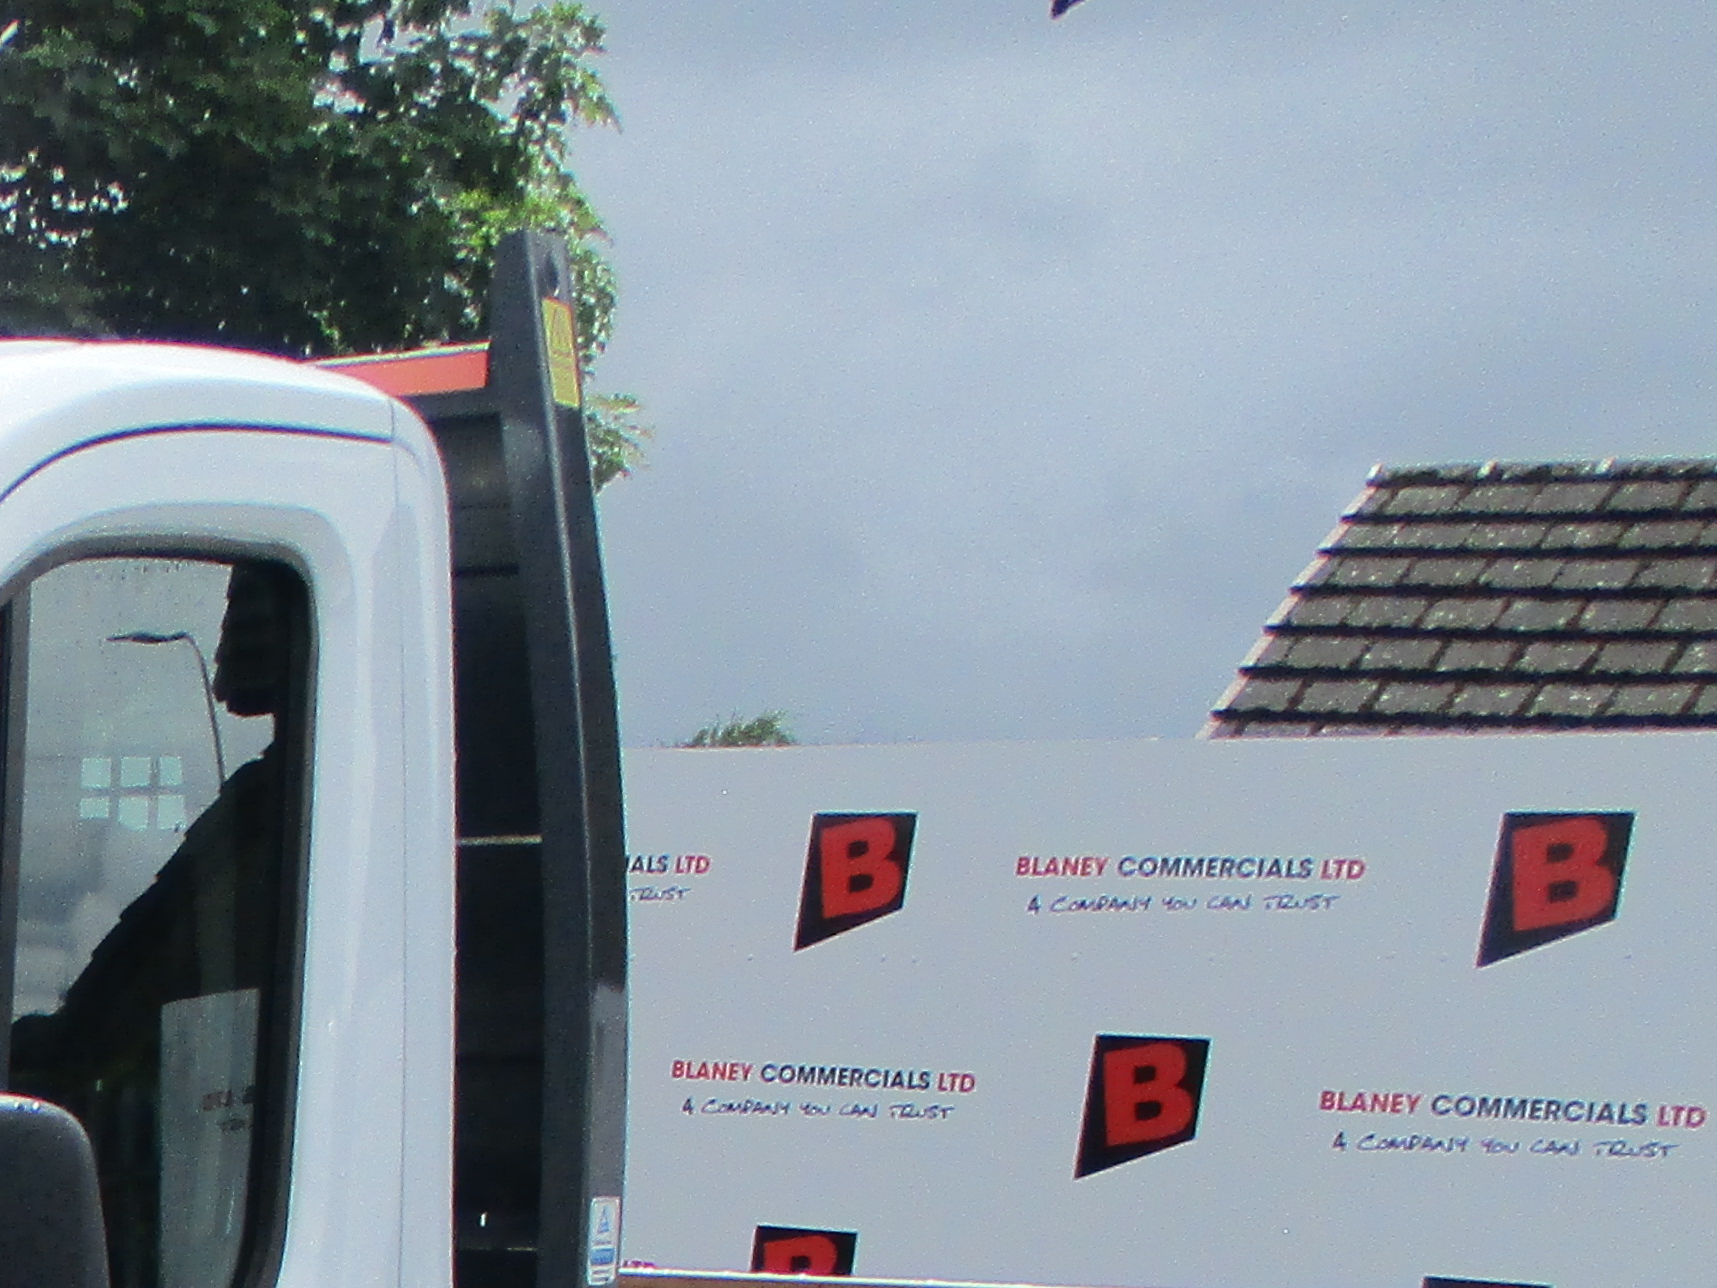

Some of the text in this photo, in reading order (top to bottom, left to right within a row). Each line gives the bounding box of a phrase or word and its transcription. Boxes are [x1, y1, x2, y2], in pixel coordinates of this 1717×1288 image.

[675, 855, 709, 874] LTD
[821, 817, 905, 919] B
[1015, 857, 1365, 880] BLANEY COMMERCIALS LTD
[1510, 815, 1618, 932] B
[1050, 895, 1151, 913] COMPANY
[1207, 894, 1252, 911] CAN
[1264, 894, 1341, 911] TRUST
[671, 1060, 975, 1093] BLANEY COMMERCIALS LTD
[1102, 1042, 1195, 1146] B
[701, 1099, 791, 1116] COMPANY
[839, 1102, 878, 1119] CAN
[889, 1104, 955, 1120] TRUST
[1319, 1091, 1706, 1129] BLANEY COMMERCIALS LTD
[1357, 1133, 1469, 1153] COMPANY
[1530, 1138, 1581, 1156] CAN
[1593, 1141, 1680, 1158] TRUST
